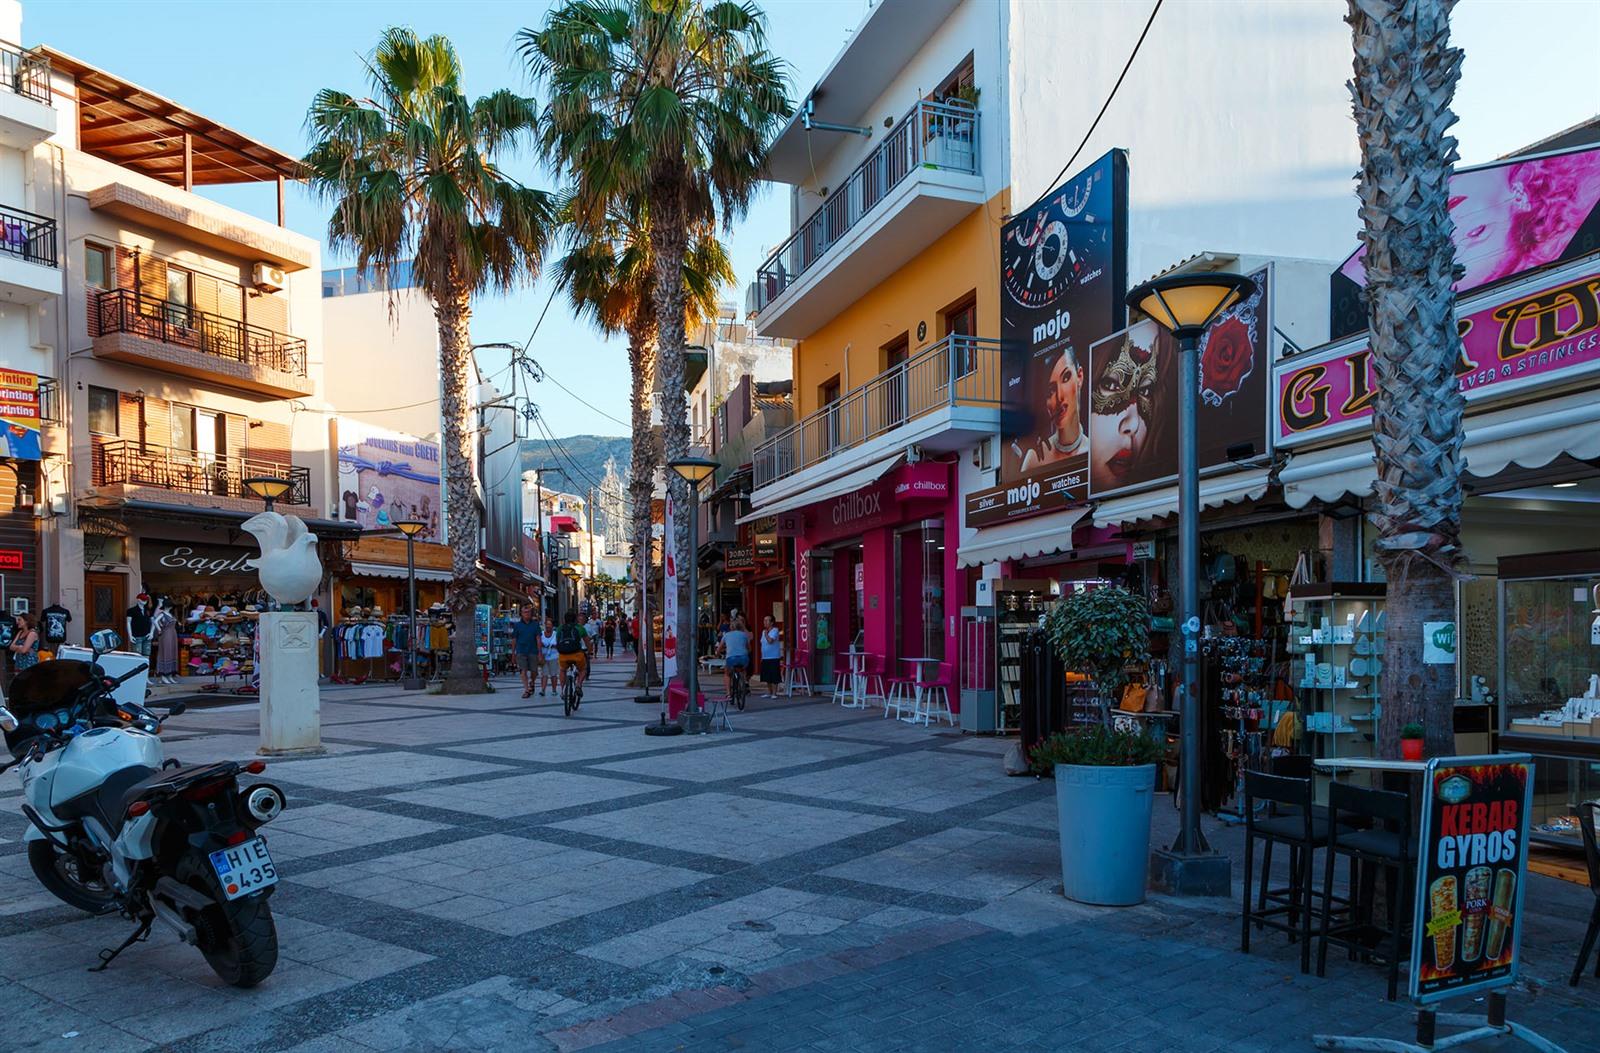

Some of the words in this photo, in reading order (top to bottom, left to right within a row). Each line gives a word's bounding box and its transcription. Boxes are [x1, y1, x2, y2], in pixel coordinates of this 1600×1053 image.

[1080, 269, 1102, 285] watches
[1033, 309, 1070, 344] mojo
[1459, 368, 1496, 391] LVER
[1517, 333, 1600, 371] STAINLES
[0, 373, 32, 386] inting
[415, 442, 438, 462] CRETE
[913, 481, 946, 490] chillbox
[979, 498, 995, 508] silver
[1007, 479, 1040, 505] mojo
[1052, 475, 1080, 490] watches
[832, 491, 881, 525] chillbox
[799, 551, 809, 642] chillbox
[1441, 800, 1518, 837] KEBAB
[227, 842, 267, 869] HIE
[1437, 829, 1517, 869] GYROS
[240, 863, 275, 888] 435
[1466, 898, 1488, 910] PORK
